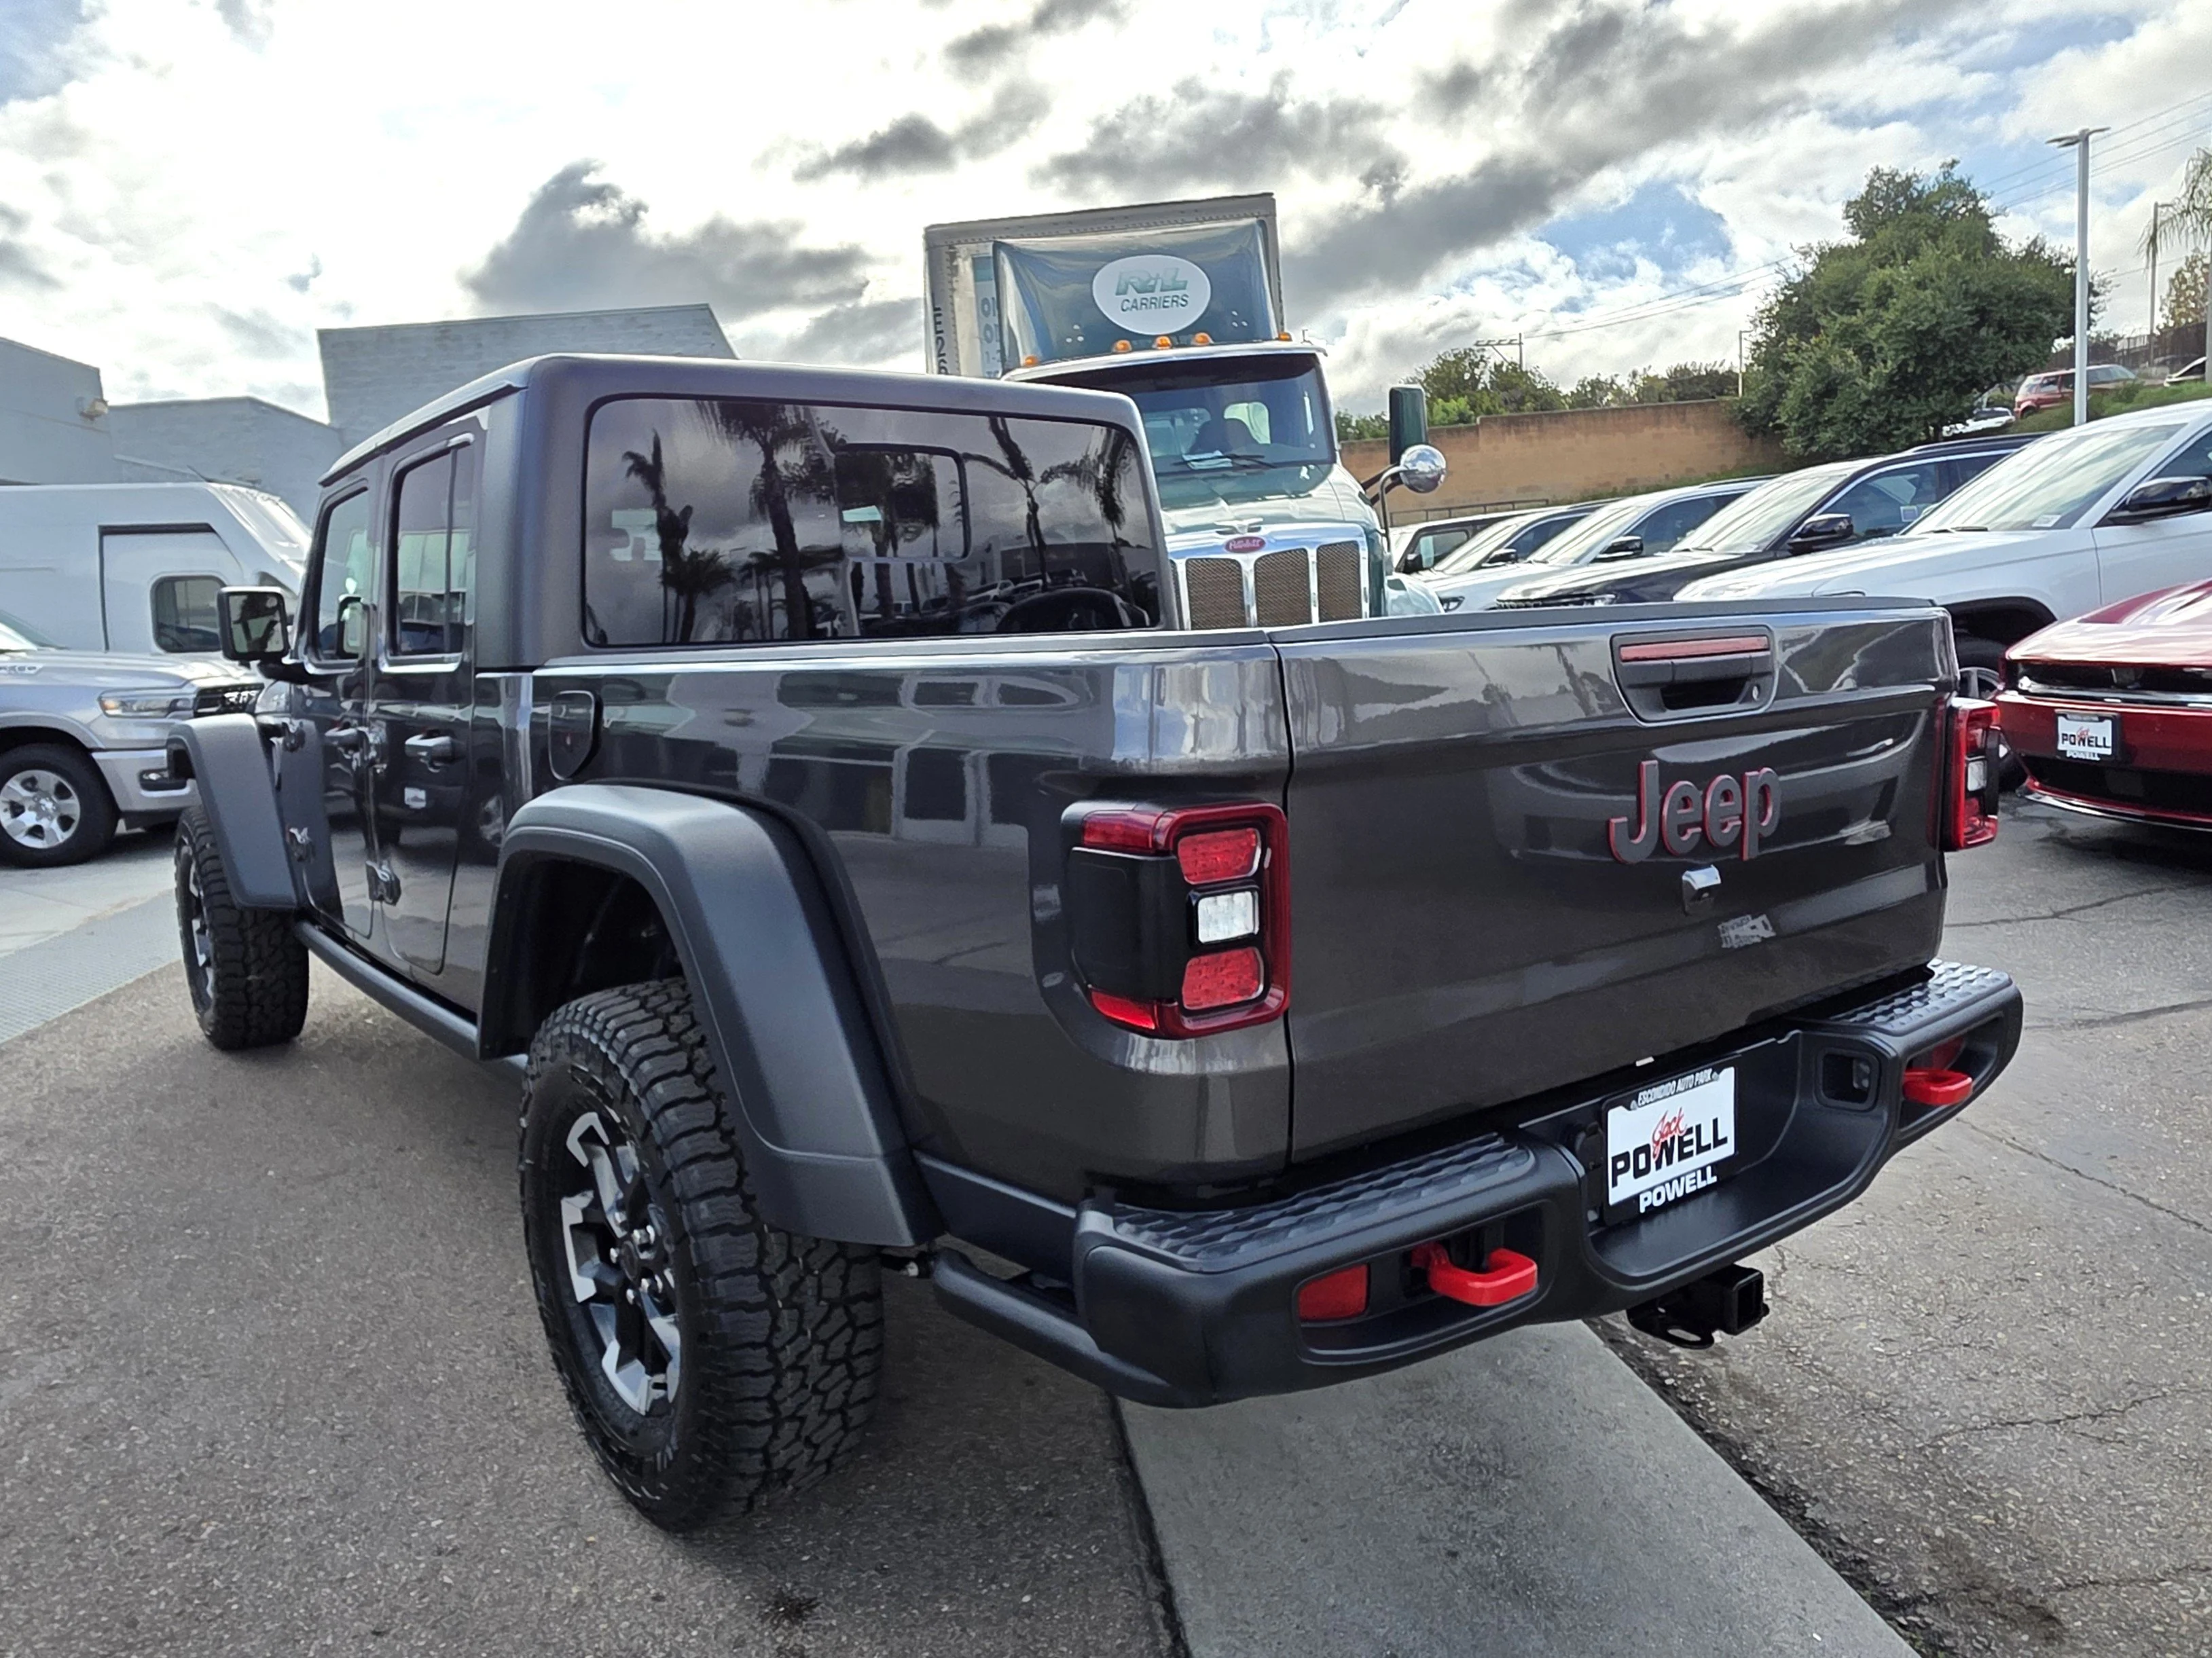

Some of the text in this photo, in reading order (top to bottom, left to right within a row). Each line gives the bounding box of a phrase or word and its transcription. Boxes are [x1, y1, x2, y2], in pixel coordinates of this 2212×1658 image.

[1121, 294, 1189, 312] CARRIERS
[2061, 733, 2111, 748] POWELL
[1608, 760, 1781, 864] Jeep
[1675, 1074, 1694, 1093] AUTO
[1694, 1068, 1712, 1086] PARK
[1611, 1118, 1728, 1188] POWELL
[1652, 1107, 1687, 1160] Jack
[1639, 1165, 1718, 1214] POWELL
